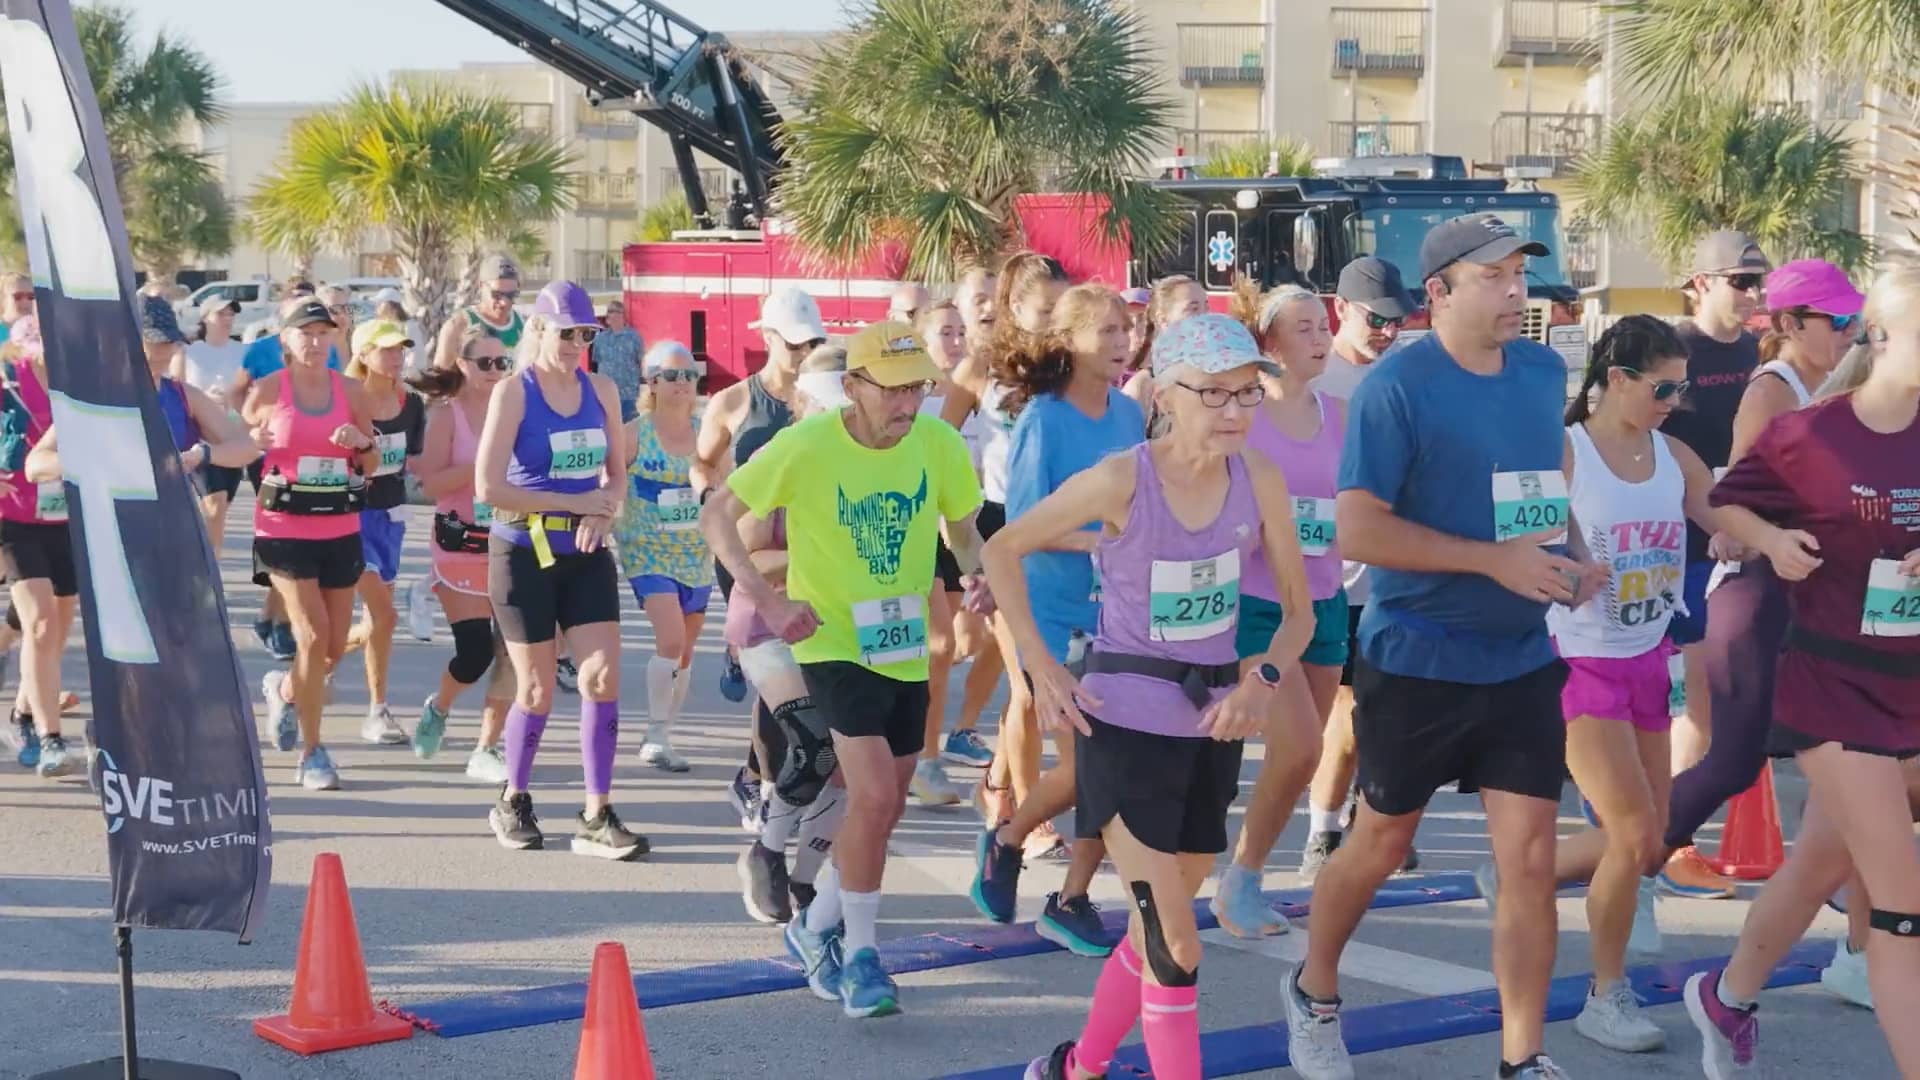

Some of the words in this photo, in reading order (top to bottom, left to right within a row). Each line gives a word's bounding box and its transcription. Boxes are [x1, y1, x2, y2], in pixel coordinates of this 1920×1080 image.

[671, 92, 691, 110] 100
[567, 452, 594, 468] 281
[672, 506, 699, 521] 312
[838, 482, 884, 527] RUNNING
[1514, 504, 1558, 528] 420
[1296, 523, 1325, 544] 54
[1610, 520, 1684, 554] THE
[1175, 591, 1225, 621] 278
[1891, 596, 1920, 618] 42
[876, 624, 912, 649] 261
